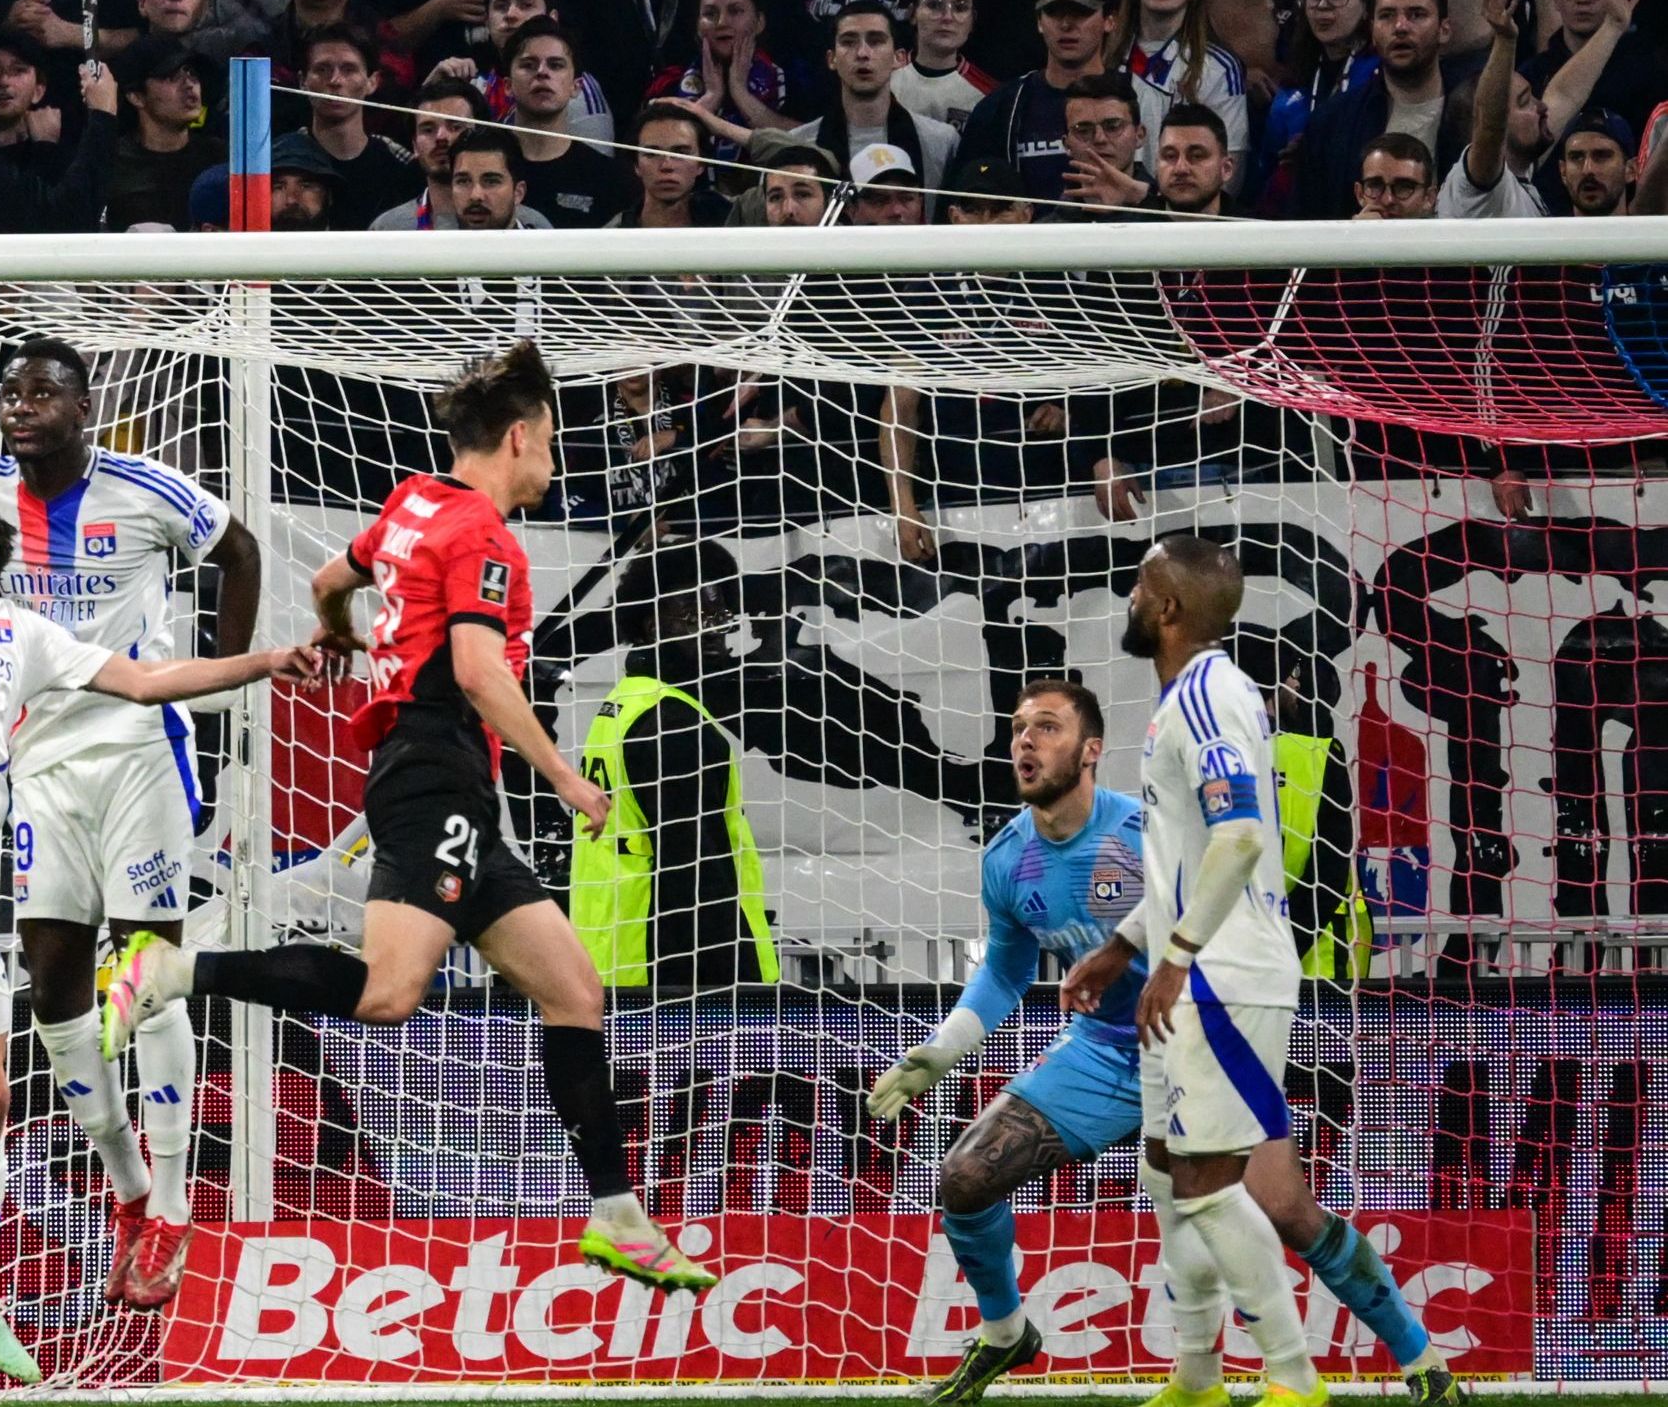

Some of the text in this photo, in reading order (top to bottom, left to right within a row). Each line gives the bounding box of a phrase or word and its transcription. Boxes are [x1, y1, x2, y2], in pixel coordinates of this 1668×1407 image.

[39, 597, 96, 622] BETTER
[126, 848, 167, 880] Staff
[131, 859, 183, 896] match
[1095, 882, 1121, 898] OL
[217, 1224, 807, 1360] Betclic
